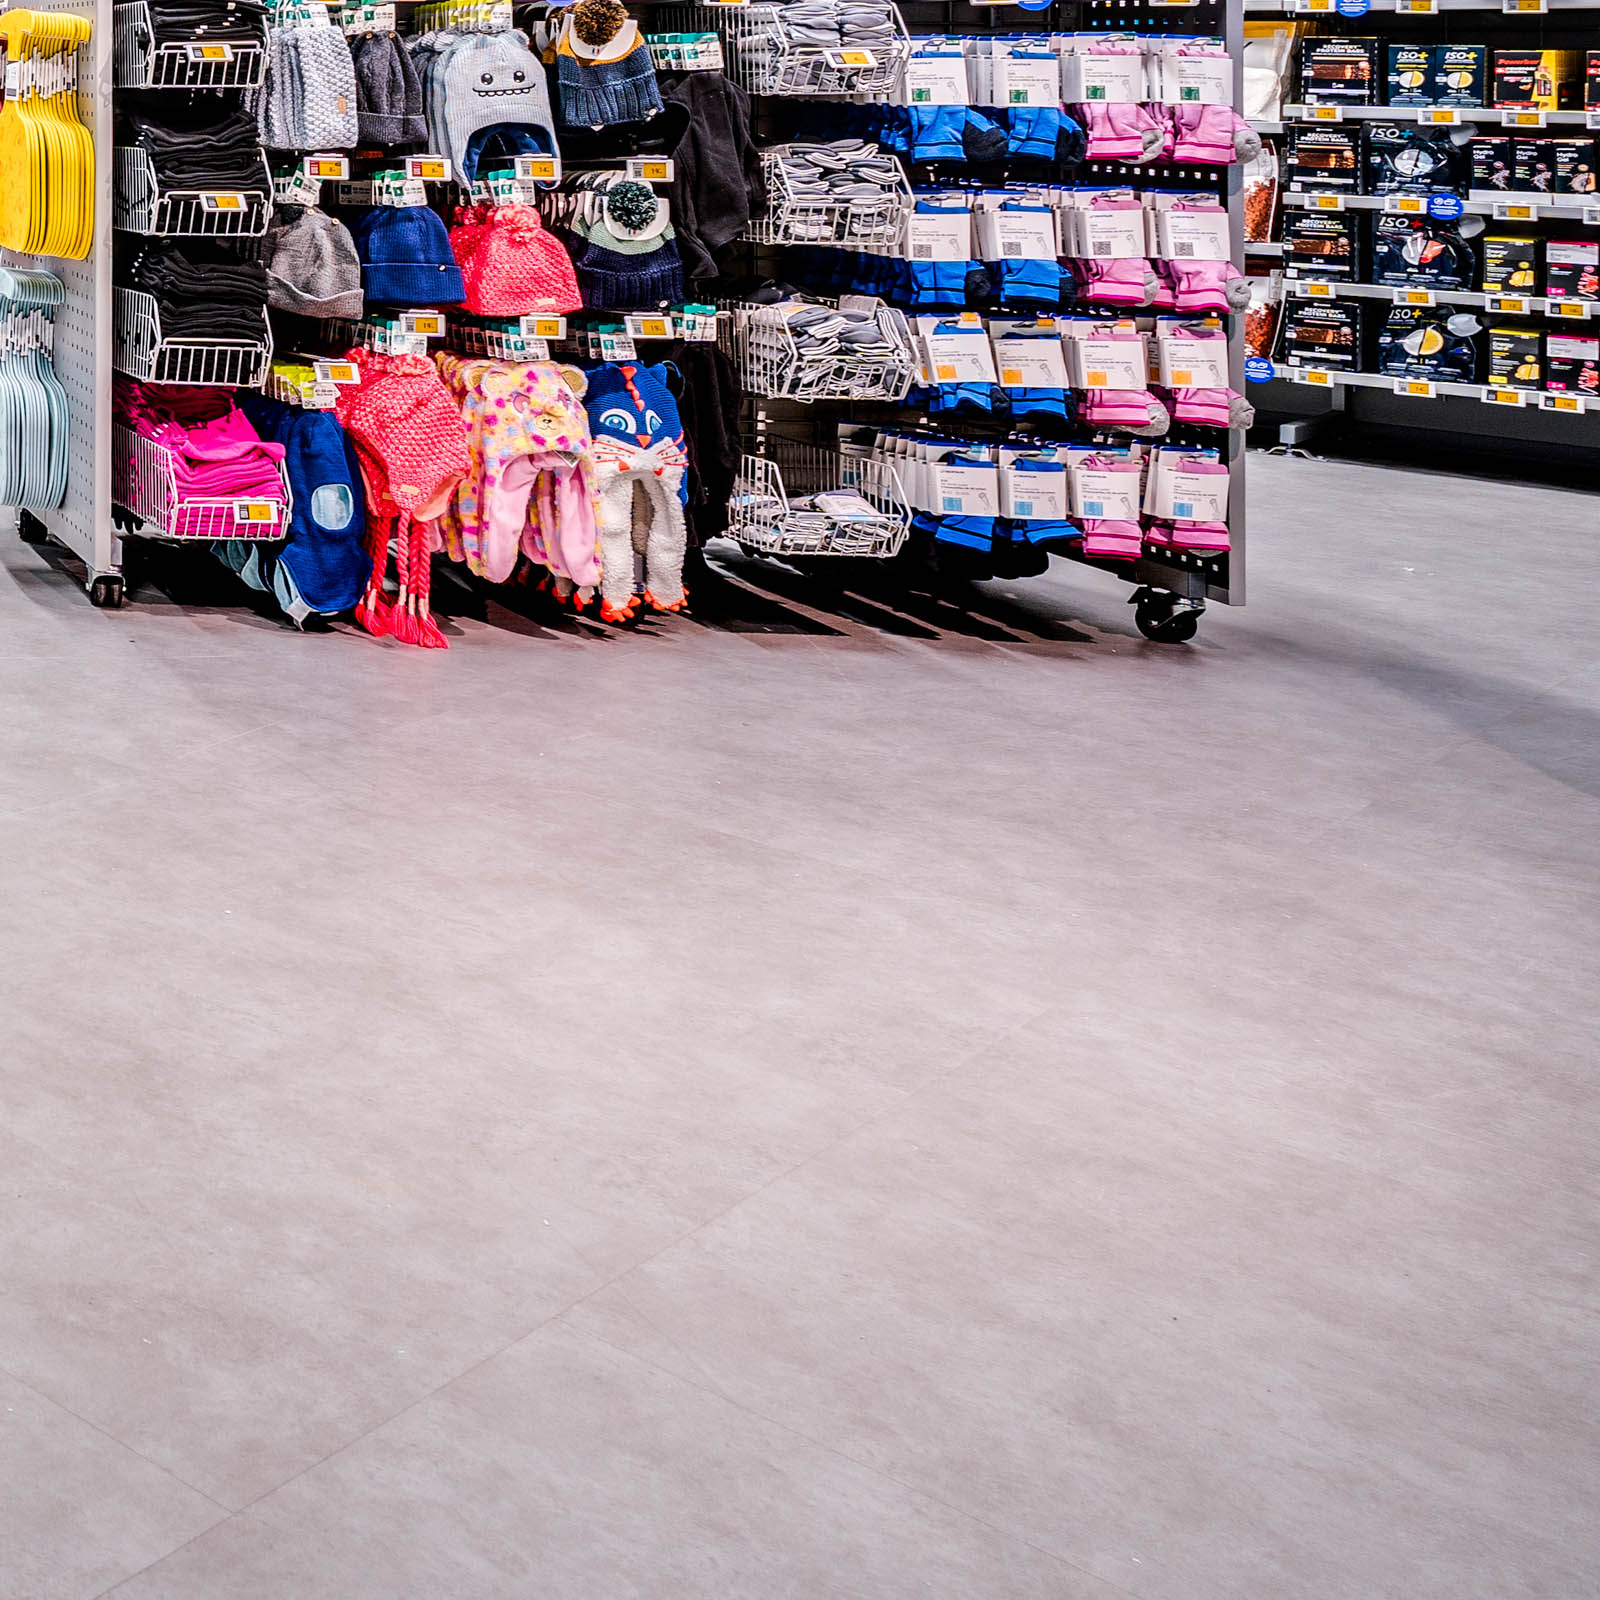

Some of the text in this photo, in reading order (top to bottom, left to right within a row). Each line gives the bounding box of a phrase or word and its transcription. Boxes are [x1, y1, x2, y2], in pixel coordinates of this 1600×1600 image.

[1369, 128, 1414, 139] ISO+
[1378, 216, 1423, 228] ISO+
[1389, 308, 1422, 320] ISO+
